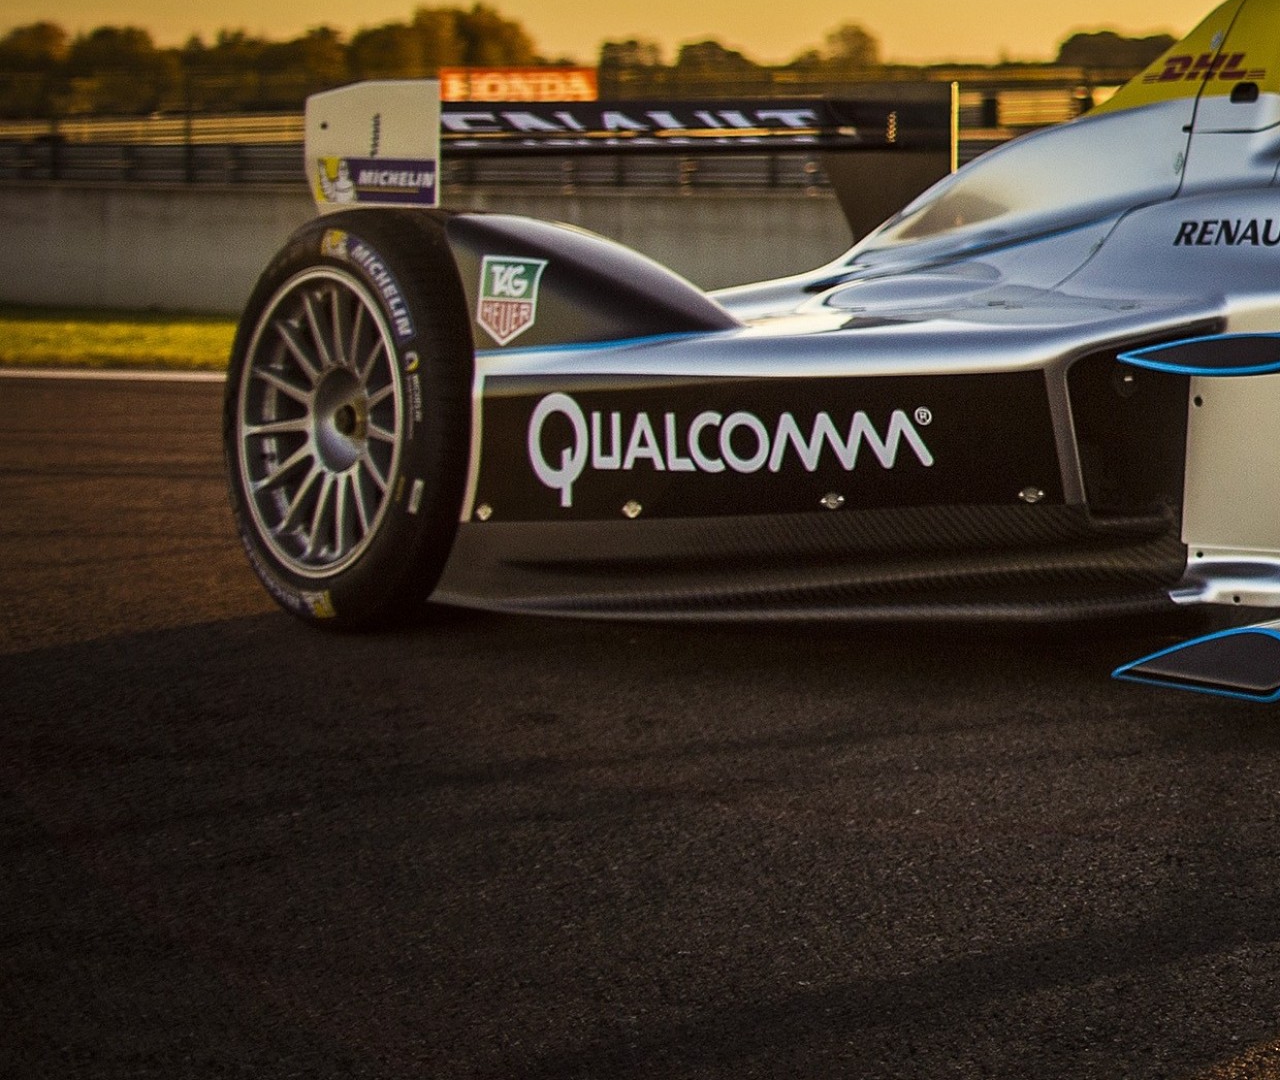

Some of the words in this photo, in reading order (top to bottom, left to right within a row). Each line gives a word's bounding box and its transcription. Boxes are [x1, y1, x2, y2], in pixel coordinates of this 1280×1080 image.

[1157, 52, 1251, 83] DHL
[357, 169, 435, 189] MICHELIN
[351, 244, 413, 337] MICHELIN
[490, 263, 529, 298] TAG
[482, 301, 531, 337] HEUER
